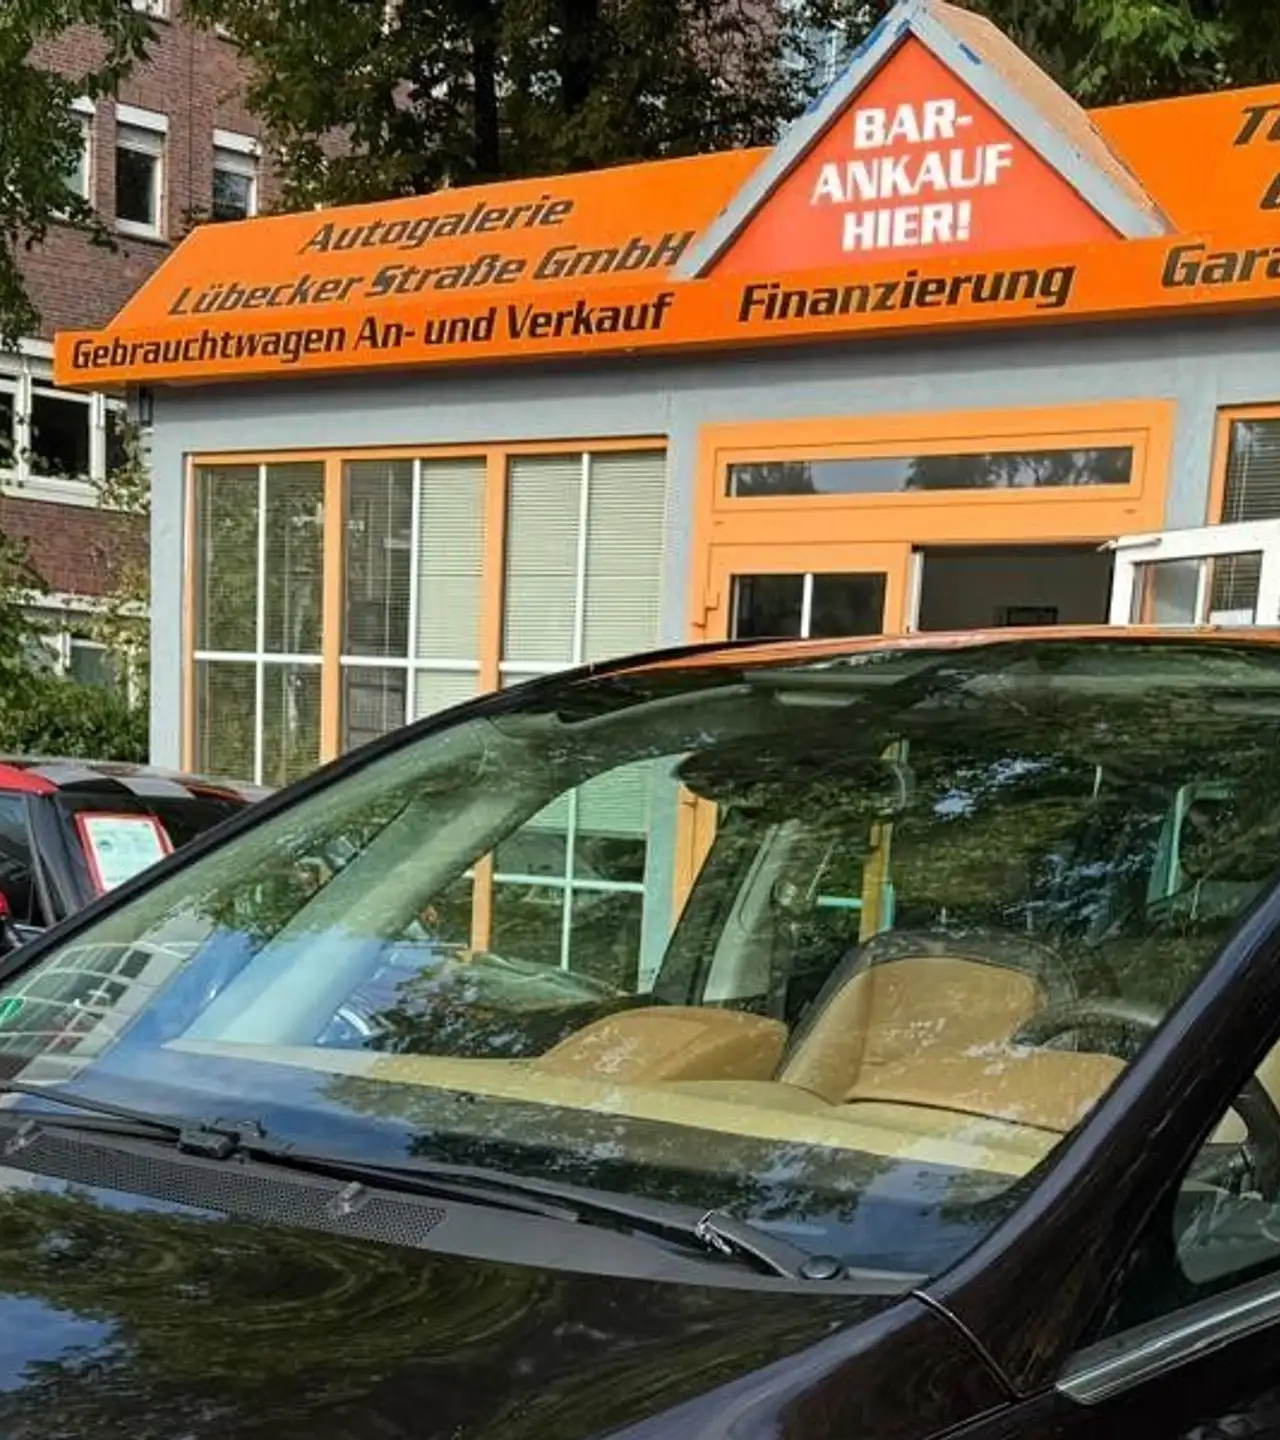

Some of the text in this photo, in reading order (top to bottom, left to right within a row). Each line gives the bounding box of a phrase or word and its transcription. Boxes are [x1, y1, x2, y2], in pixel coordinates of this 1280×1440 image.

[853, 97, 974, 149] BAR-
[811, 143, 1014, 204] ANKAUF
[297, 194, 574, 255] Autogalerie
[841, 200, 973, 251] HIER!
[168, 230, 697, 316] Lübecker Straße GmbH
[738, 264, 1076, 322] Finanzierung
[72, 292, 676, 370] Gebrauchtwagen An- und Verkauf
